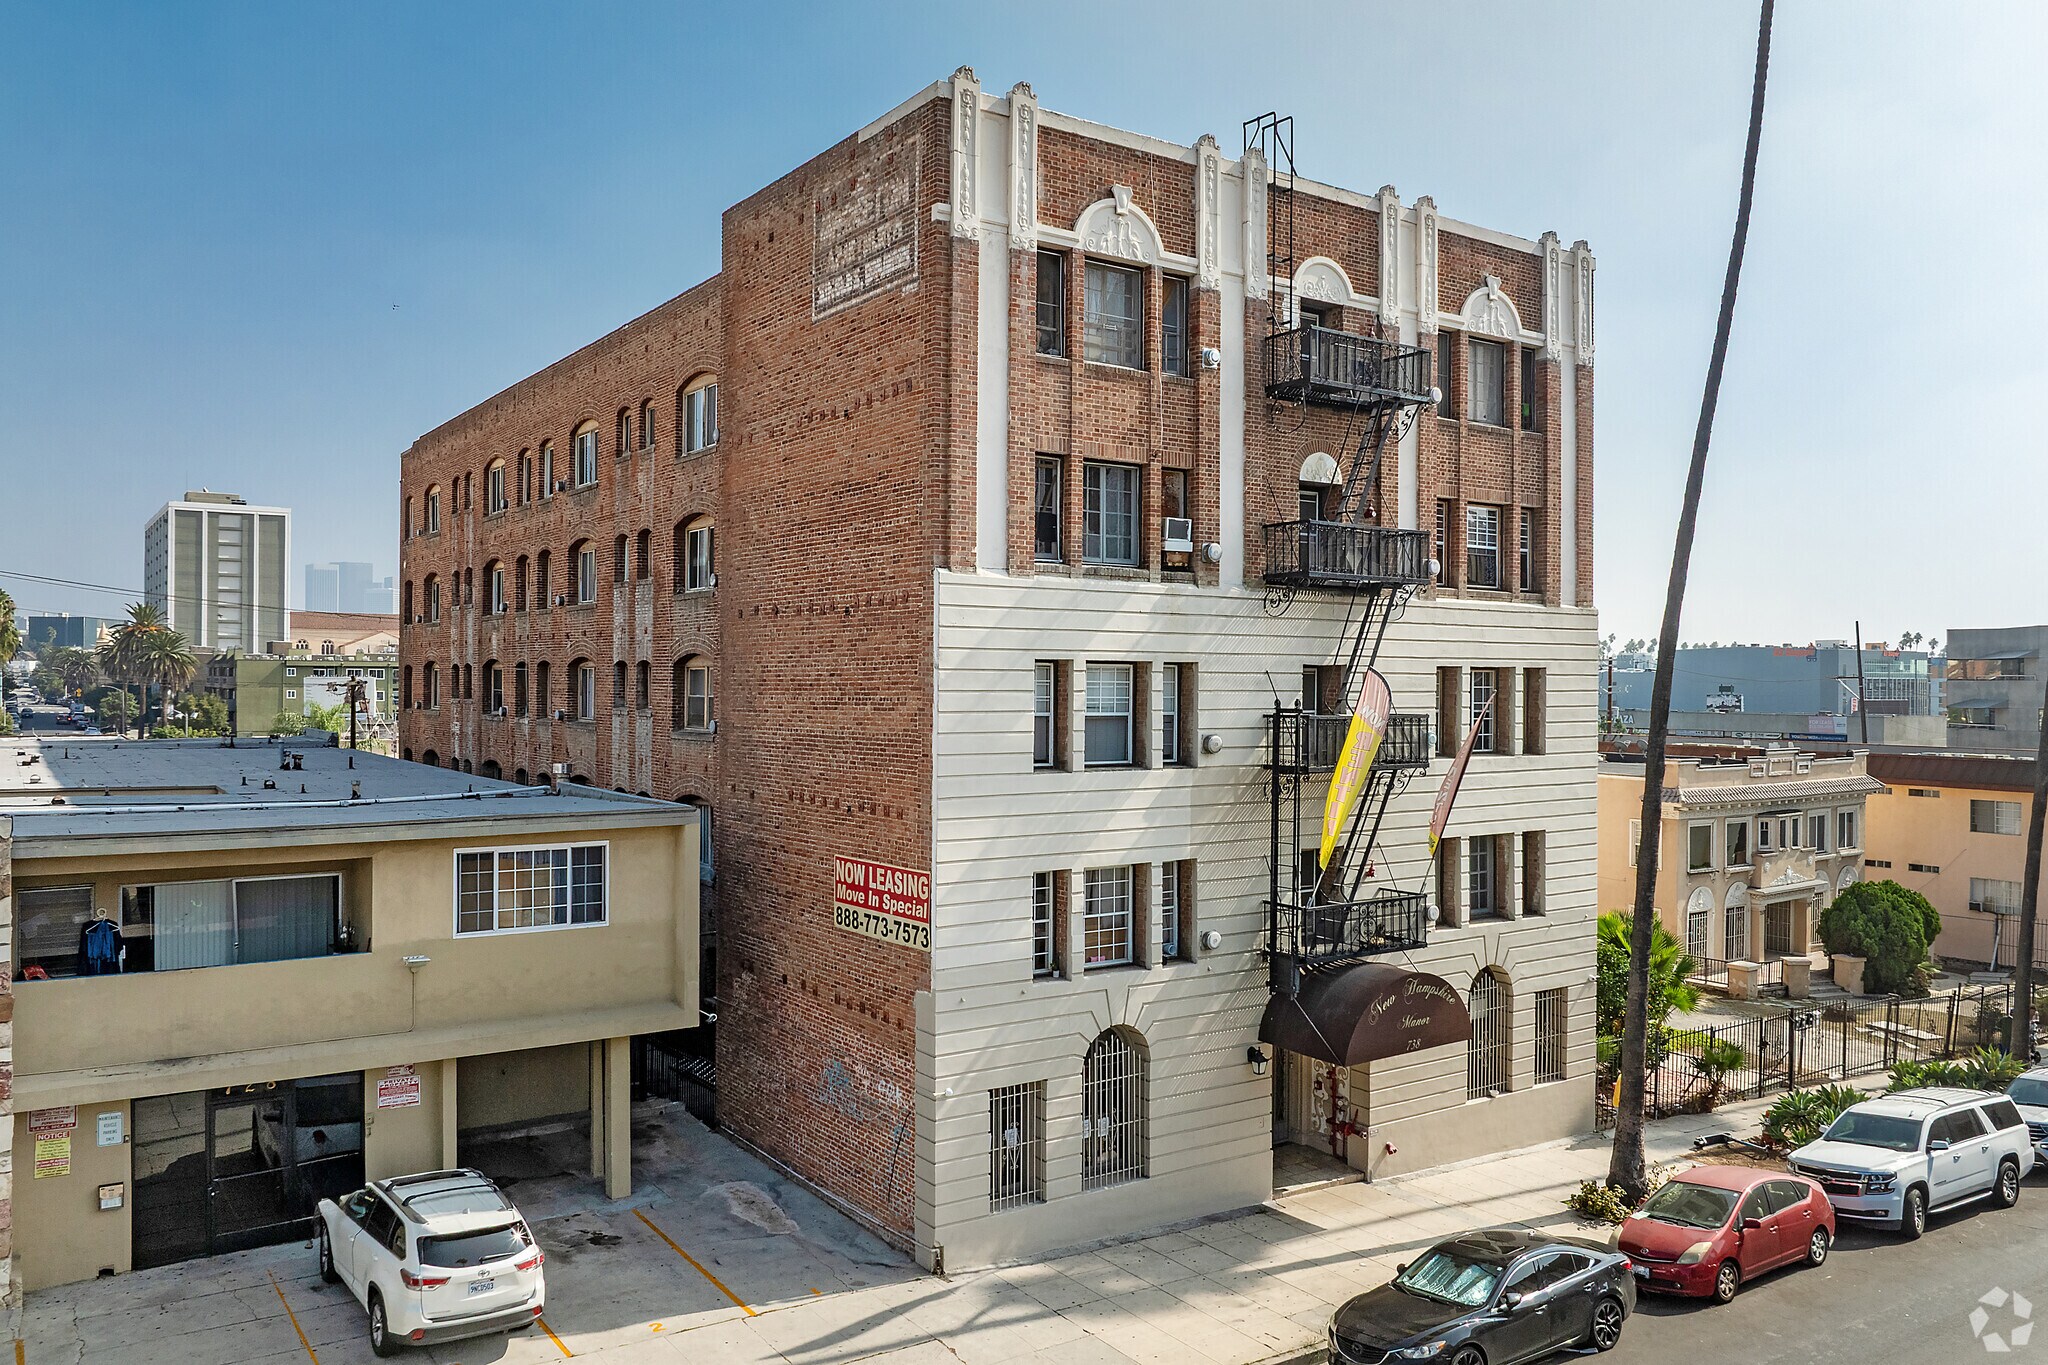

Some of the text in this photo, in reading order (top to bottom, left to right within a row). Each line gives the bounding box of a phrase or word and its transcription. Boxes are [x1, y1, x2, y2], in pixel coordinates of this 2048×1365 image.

[836, 860, 929, 900] NOW LEASING
[837, 883, 928, 919] Move In Special
[836, 906, 929, 948] 888-773-7573
[1368, 977, 1456, 1025] New Hampshire
[1397, 1013, 1431, 1030] Manor
[1406, 1038, 1421, 1051] 738
[38, 1132, 67, 1140] NOTICE
[648, 1322, 667, 1333] 2
